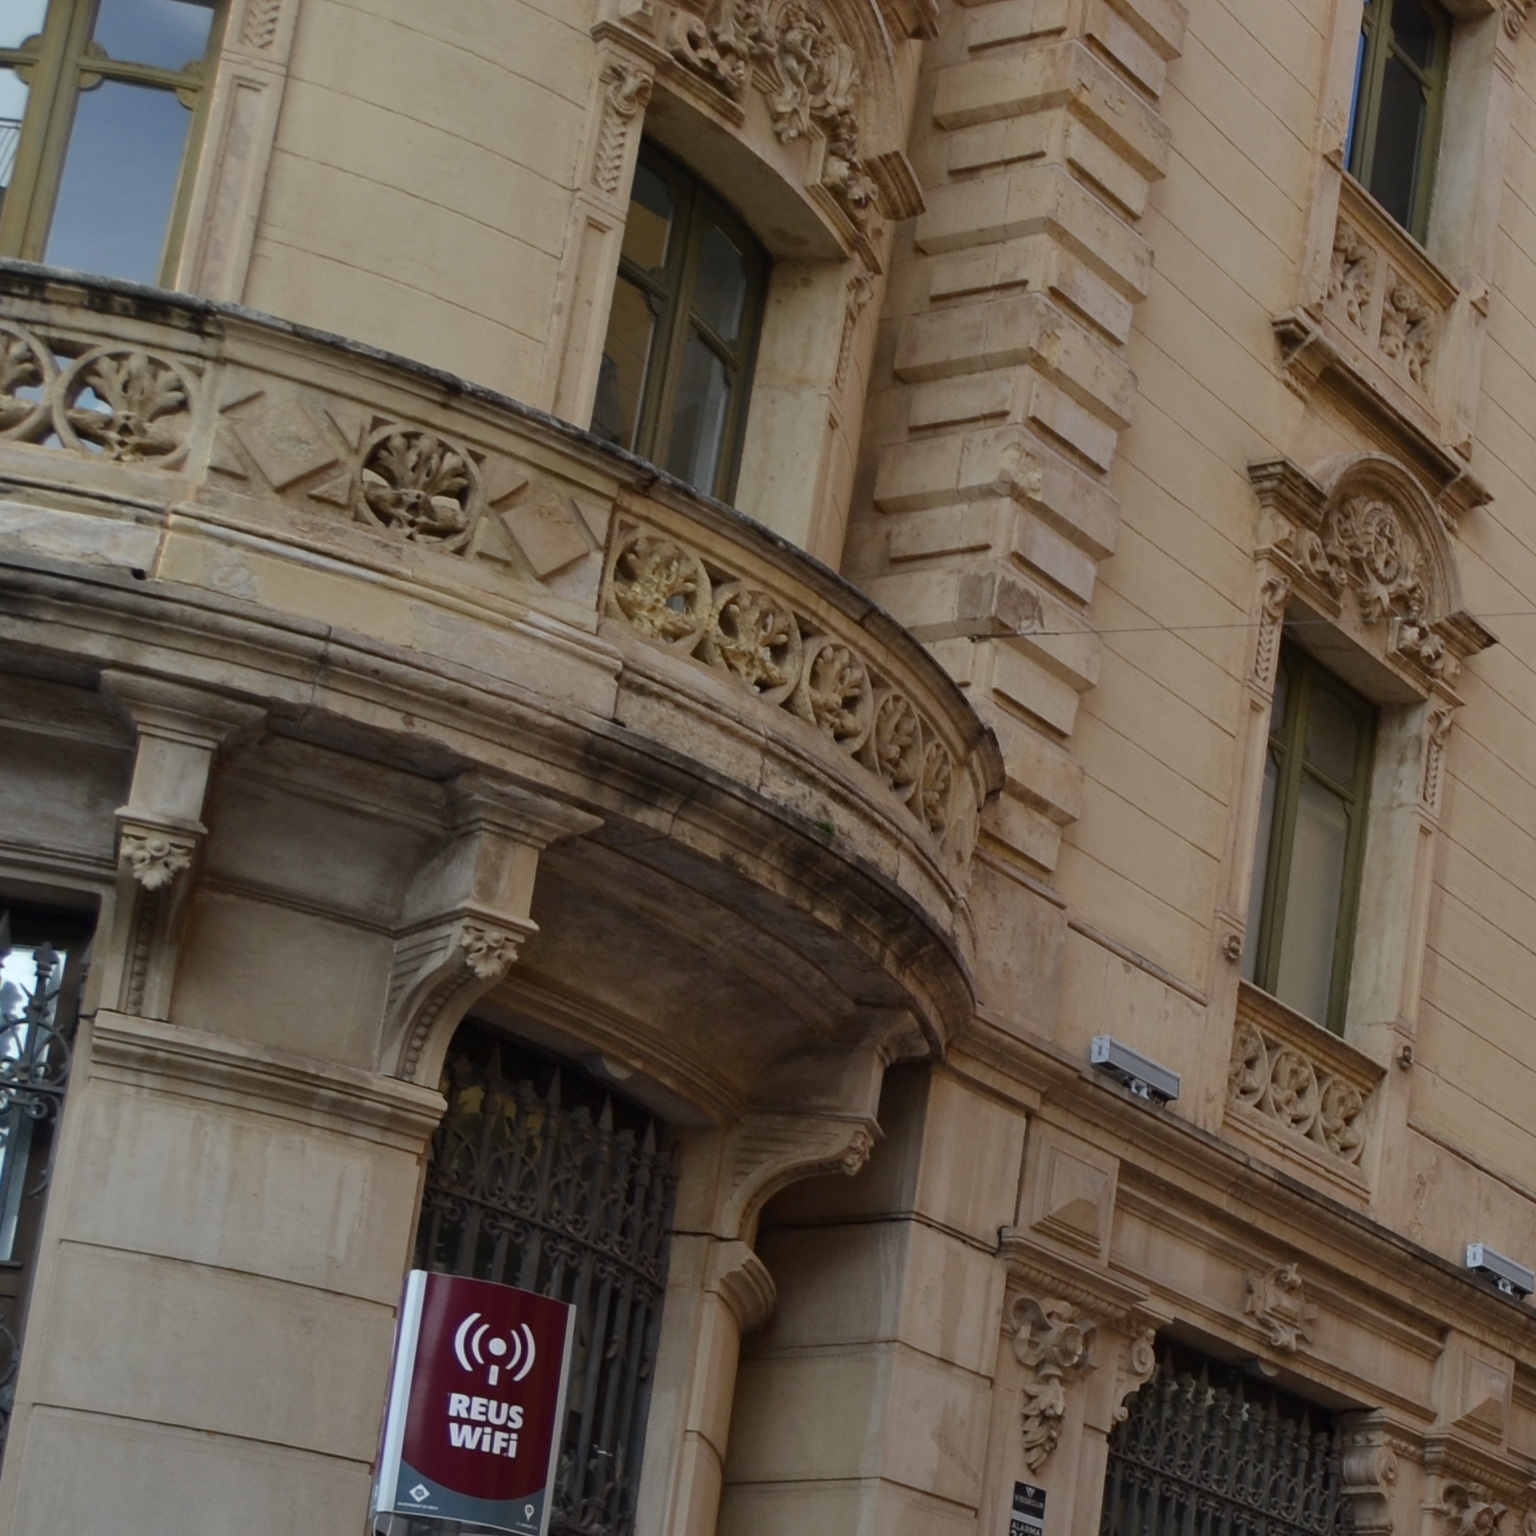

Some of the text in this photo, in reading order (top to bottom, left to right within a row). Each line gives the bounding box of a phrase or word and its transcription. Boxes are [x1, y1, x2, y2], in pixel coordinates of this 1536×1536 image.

[448, 1392, 525, 1430] REUS
[449, 1422, 518, 1459] WiFi
[1011, 1521, 1040, 1536] ALARMA
